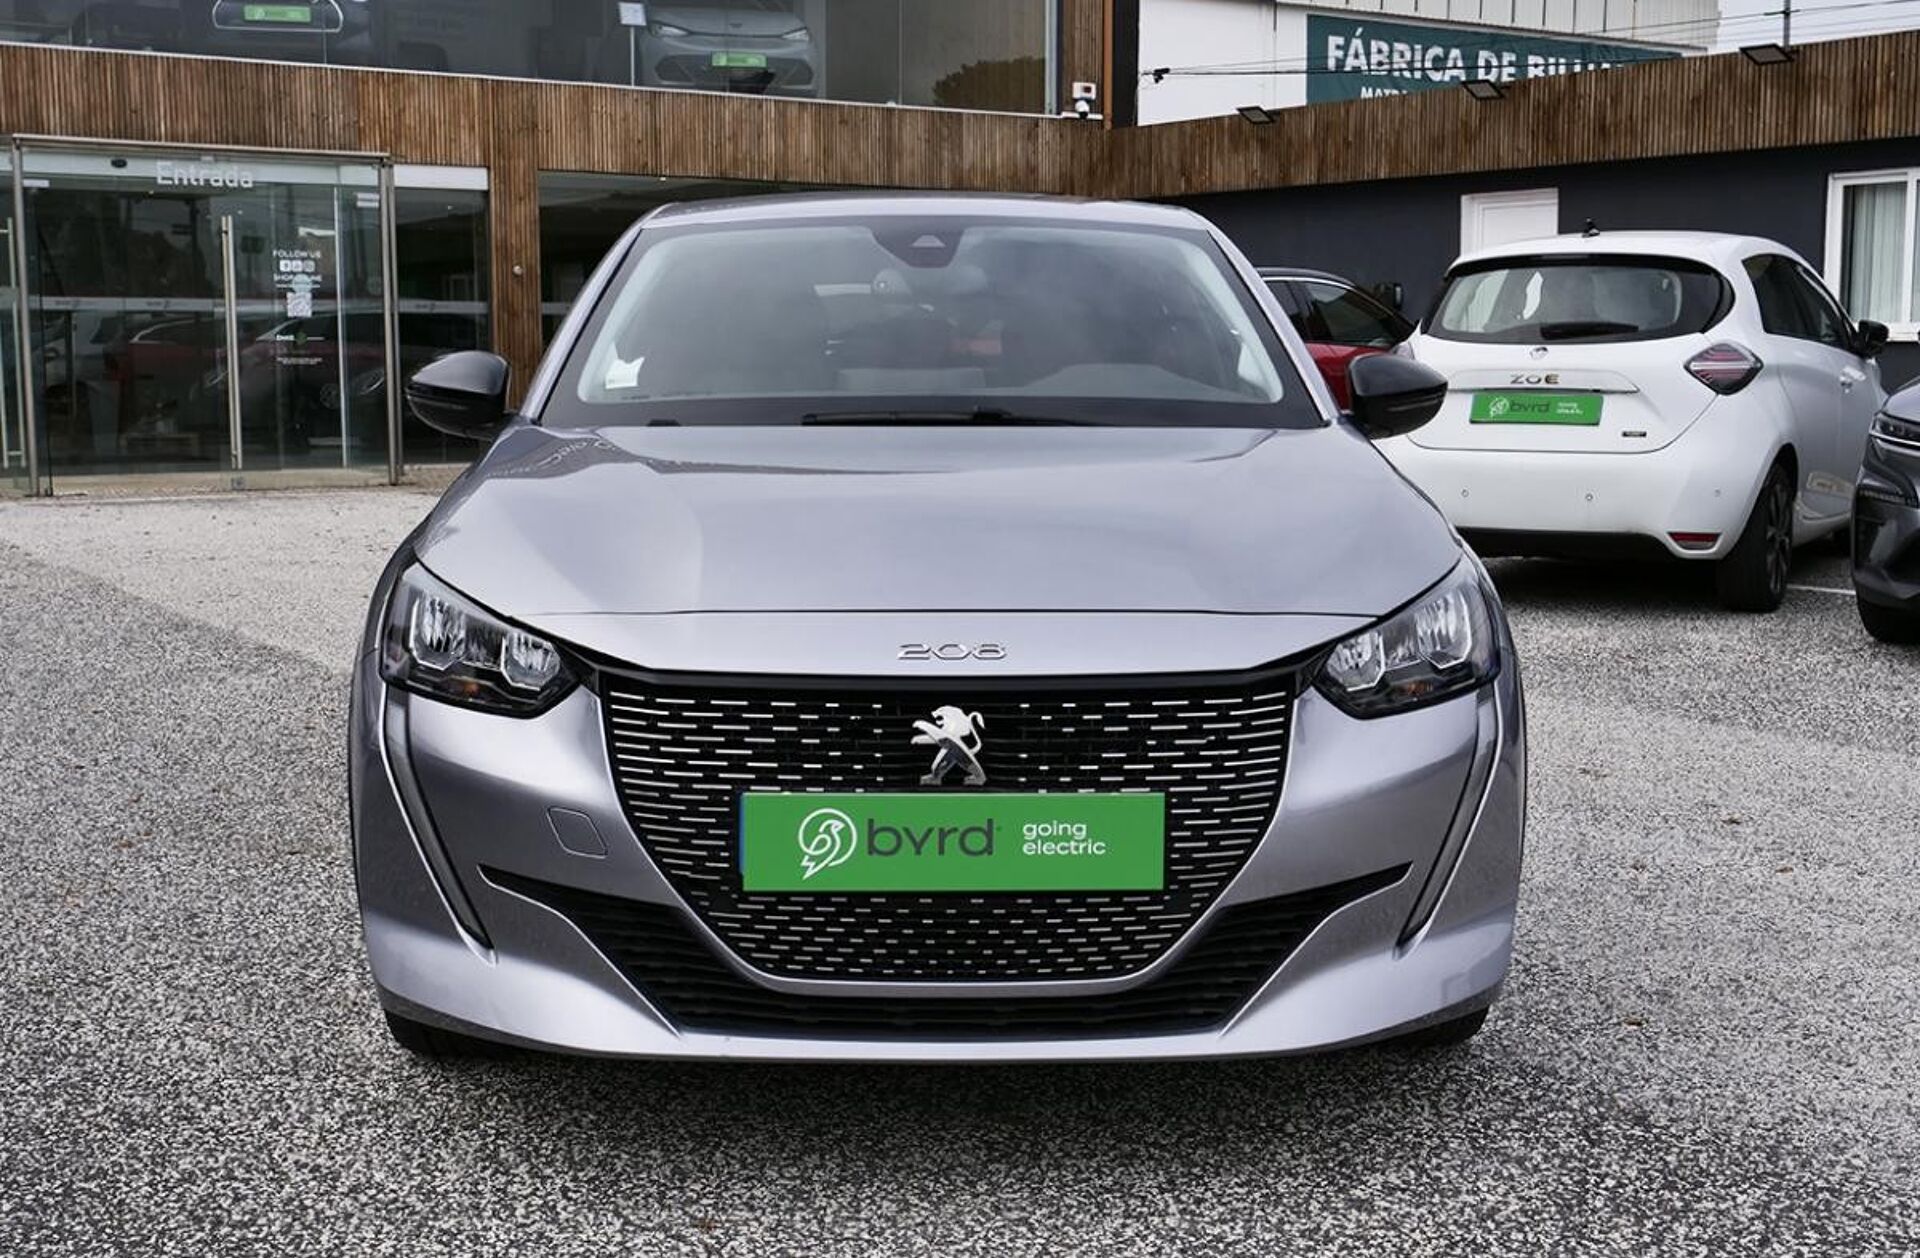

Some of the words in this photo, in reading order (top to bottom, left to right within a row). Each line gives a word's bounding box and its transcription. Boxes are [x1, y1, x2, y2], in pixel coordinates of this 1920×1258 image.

[1327, 28, 1466, 82] FÁBRICA
[1477, 50, 1516, 82] DE
[157, 161, 254, 188] Entrada
[1510, 374, 1560, 385] ZOE
[898, 643, 1007, 661] 208
[867, 818, 994, 856] byrd
[1022, 820, 1087, 840] going
[1022, 838, 1106, 855] electric
